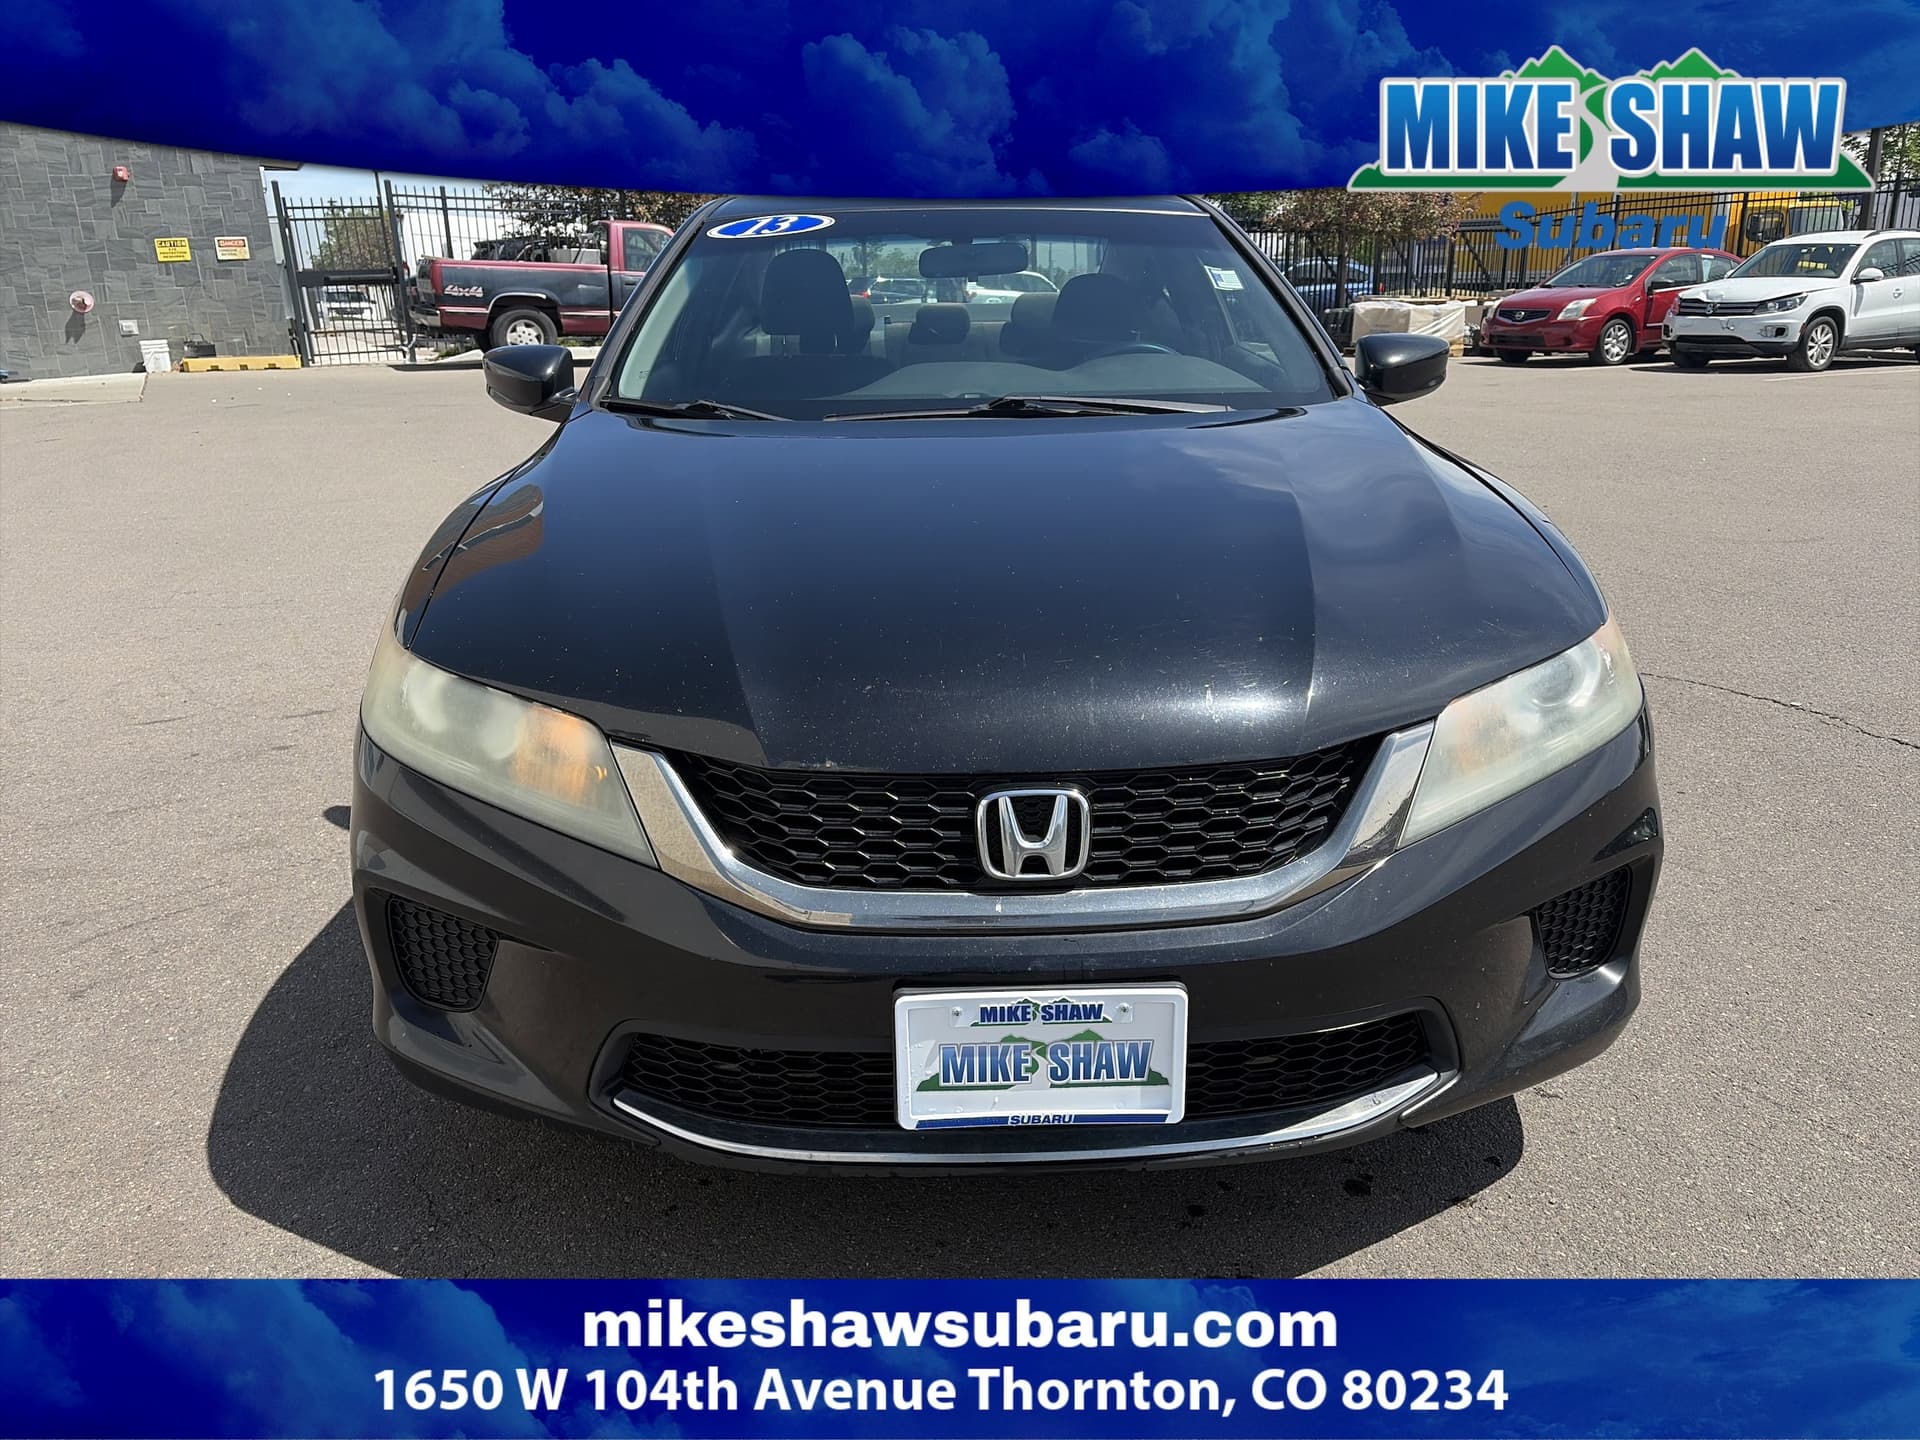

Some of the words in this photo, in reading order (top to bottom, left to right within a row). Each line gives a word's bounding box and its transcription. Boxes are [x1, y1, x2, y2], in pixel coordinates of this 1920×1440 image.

[735, 216, 799, 237] 13
[157, 239, 187, 247] CAUTION
[979, 1004, 1031, 1023] MIKE
[1041, 1003, 1103, 1022] SHAW
[940, 1043, 1031, 1085] MIKE
[1047, 1041, 1153, 1084] SHAW
[1009, 1113, 1073, 1126] SUBARU
